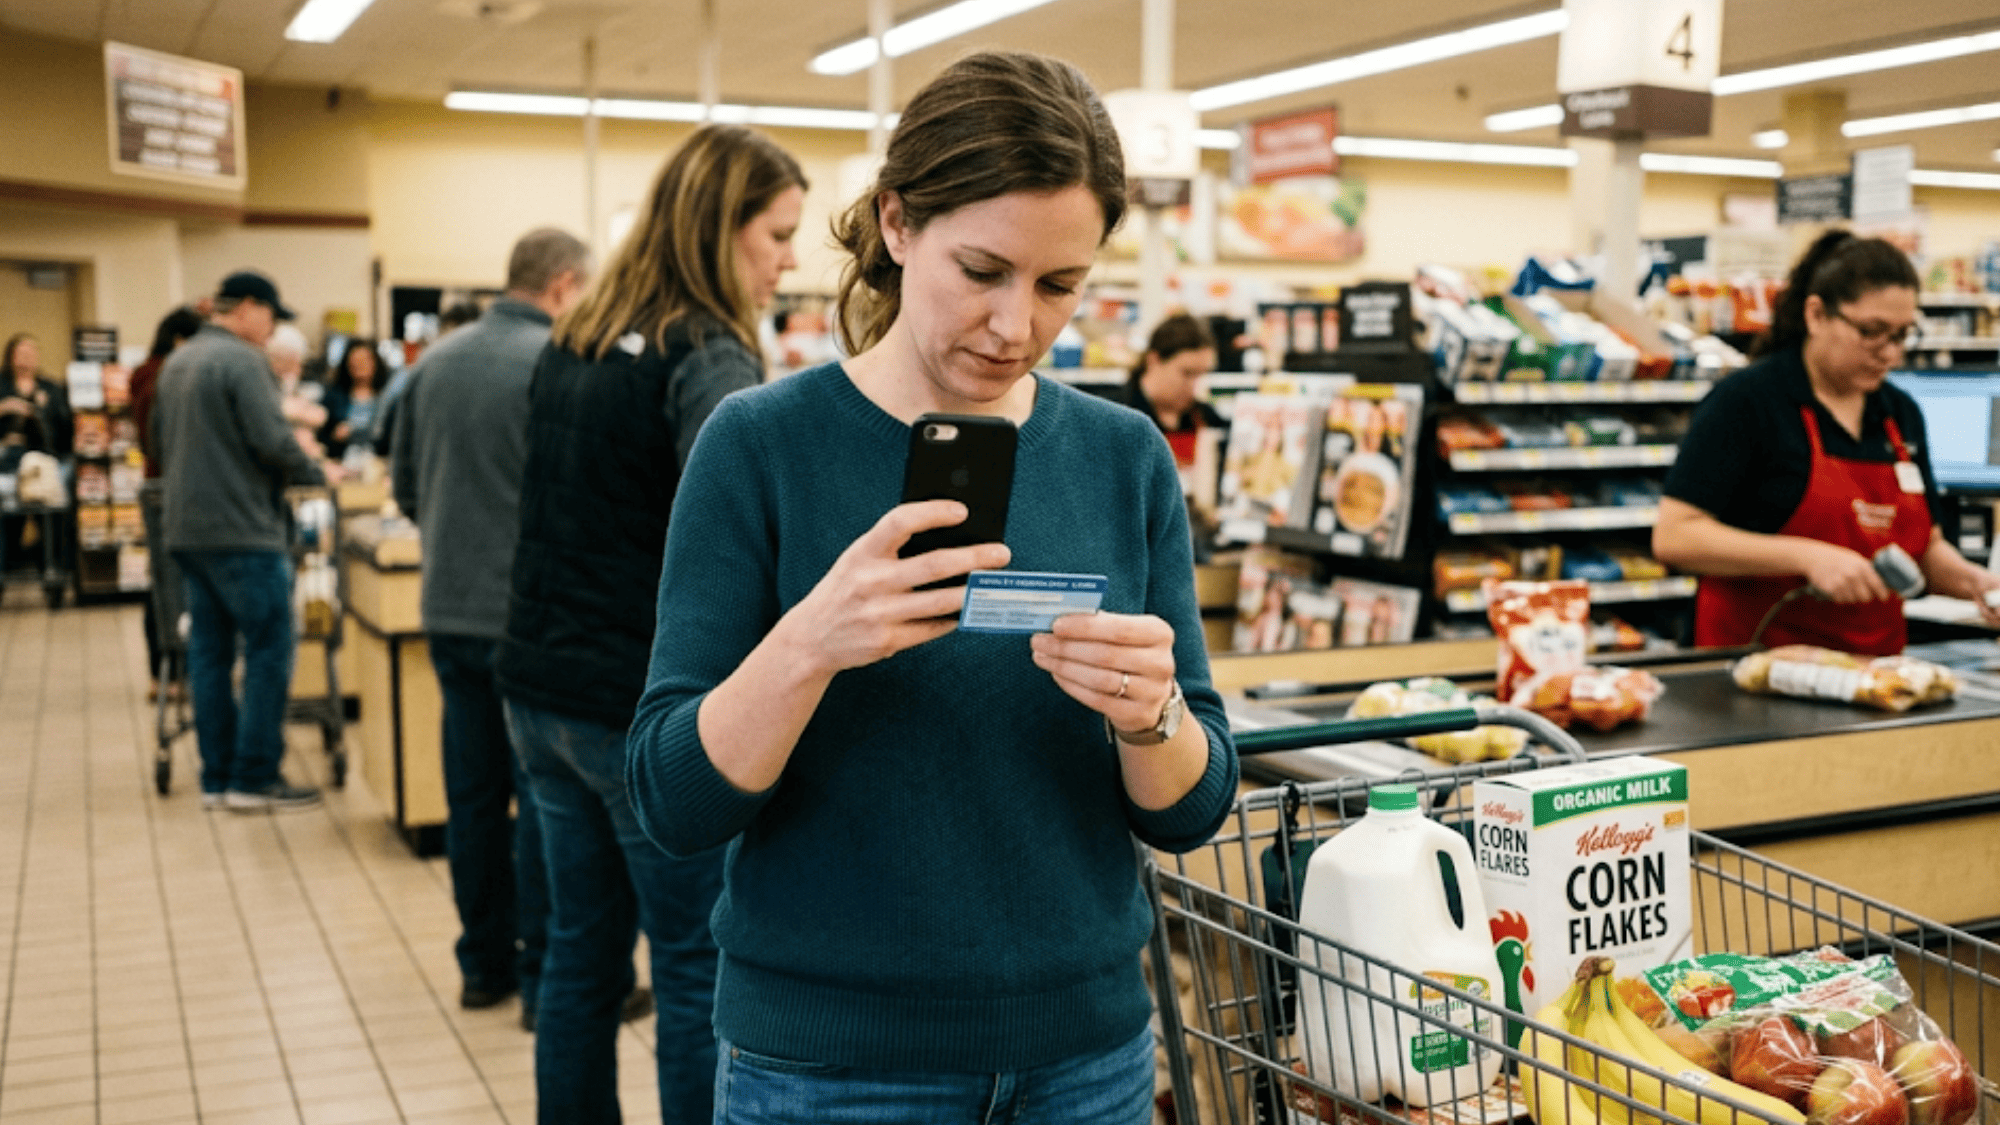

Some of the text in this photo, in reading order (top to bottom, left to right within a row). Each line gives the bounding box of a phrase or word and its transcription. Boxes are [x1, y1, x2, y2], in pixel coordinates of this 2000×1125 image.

[1665, 12, 1694, 70] 4
[1150, 121, 1172, 165] 3
[1553, 776, 1672, 811] ORGANIC MILK
[1479, 823, 1528, 854] CORN
[1576, 822, 1655, 857] Kellogg's
[1566, 851, 1666, 912] CORN
[1569, 902, 1668, 955] FLAKES
